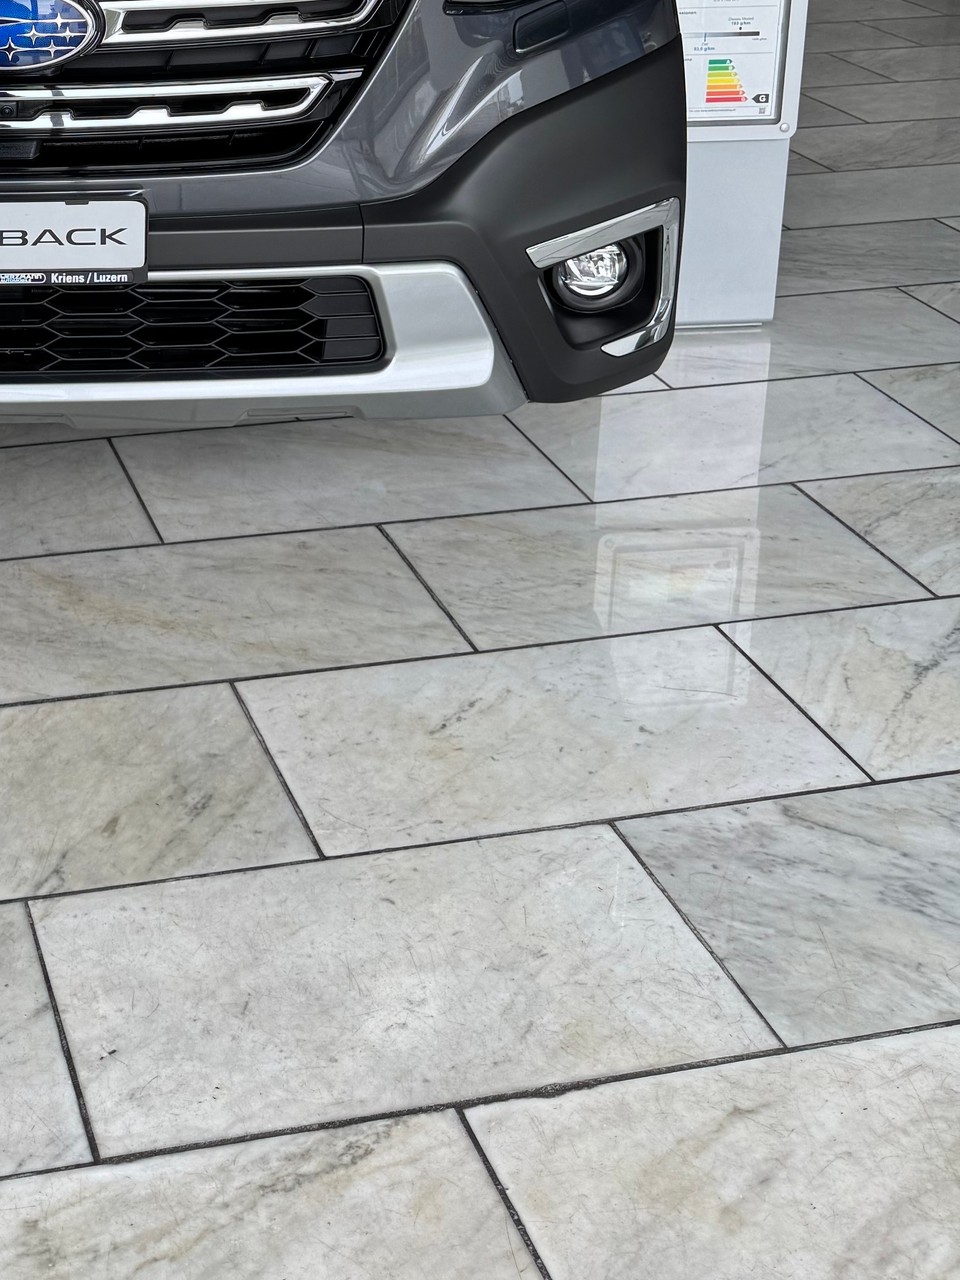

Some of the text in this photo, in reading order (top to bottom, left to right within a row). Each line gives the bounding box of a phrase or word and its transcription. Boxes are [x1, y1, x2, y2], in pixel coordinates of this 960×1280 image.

[51, 272, 85, 283] Kriens
[86, 272, 92, 284] /
[93, 272, 128, 282] Luzern
